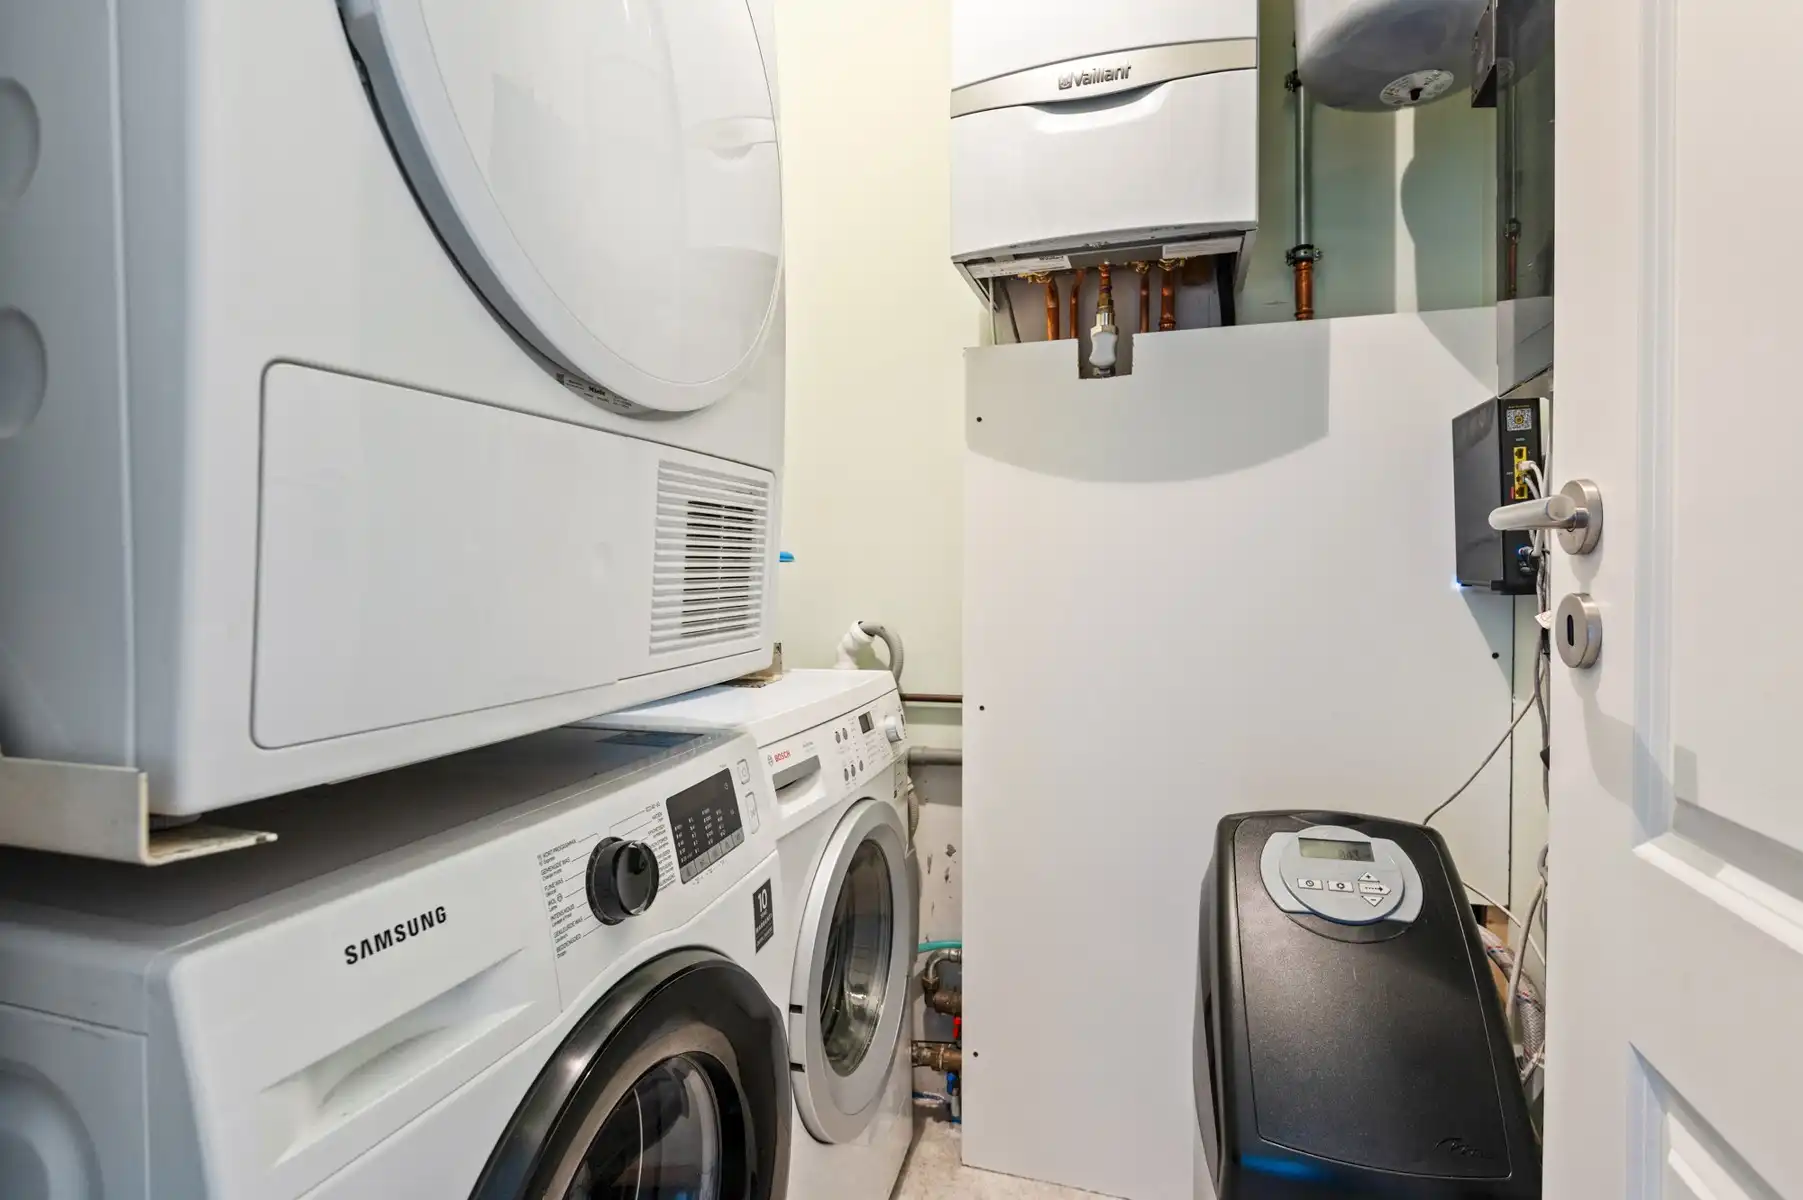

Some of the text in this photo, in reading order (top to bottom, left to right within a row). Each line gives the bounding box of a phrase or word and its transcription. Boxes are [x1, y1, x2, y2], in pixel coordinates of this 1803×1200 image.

[1074, 61, 1132, 87] Vaillant
[774, 750, 791, 762] BOSCH
[757, 888, 768, 912] 10
[344, 905, 447, 965] SAMSUNG
